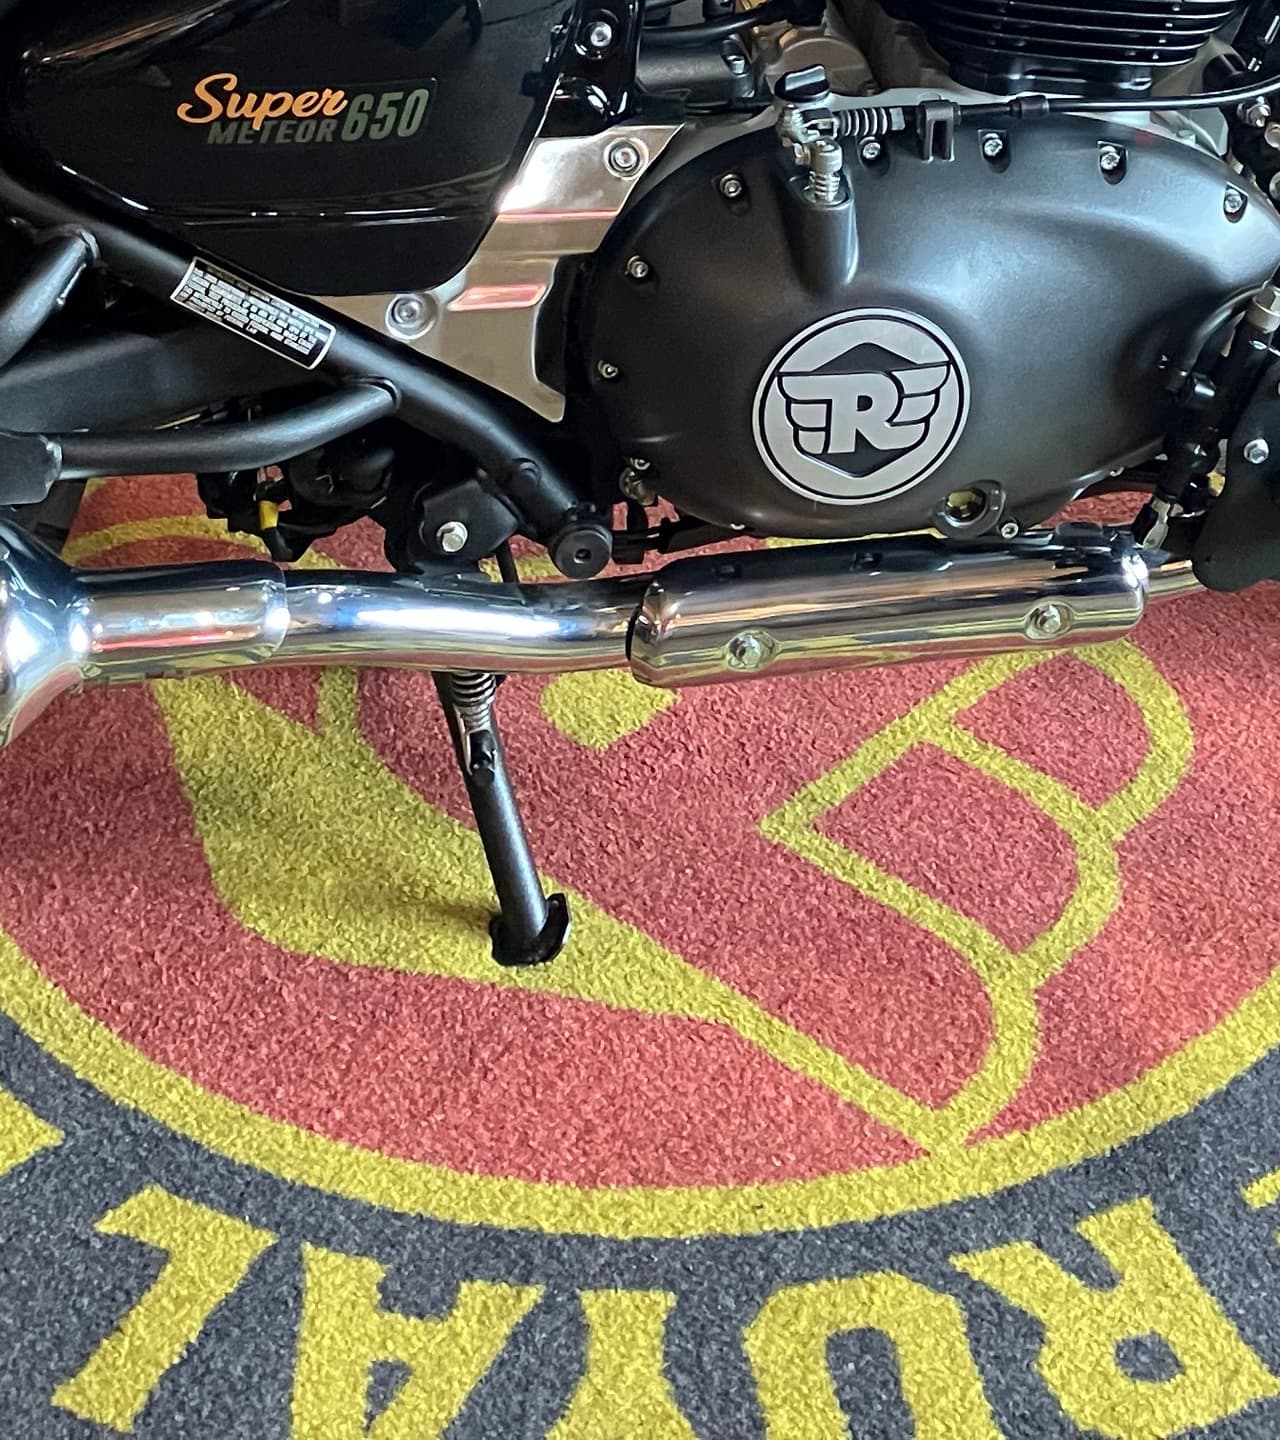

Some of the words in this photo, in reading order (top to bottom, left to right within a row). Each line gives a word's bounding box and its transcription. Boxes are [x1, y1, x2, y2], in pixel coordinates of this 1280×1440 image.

[176, 72, 349, 131] Super
[207, 117, 338, 146] METEOR
[341, 86, 430, 143] 650
